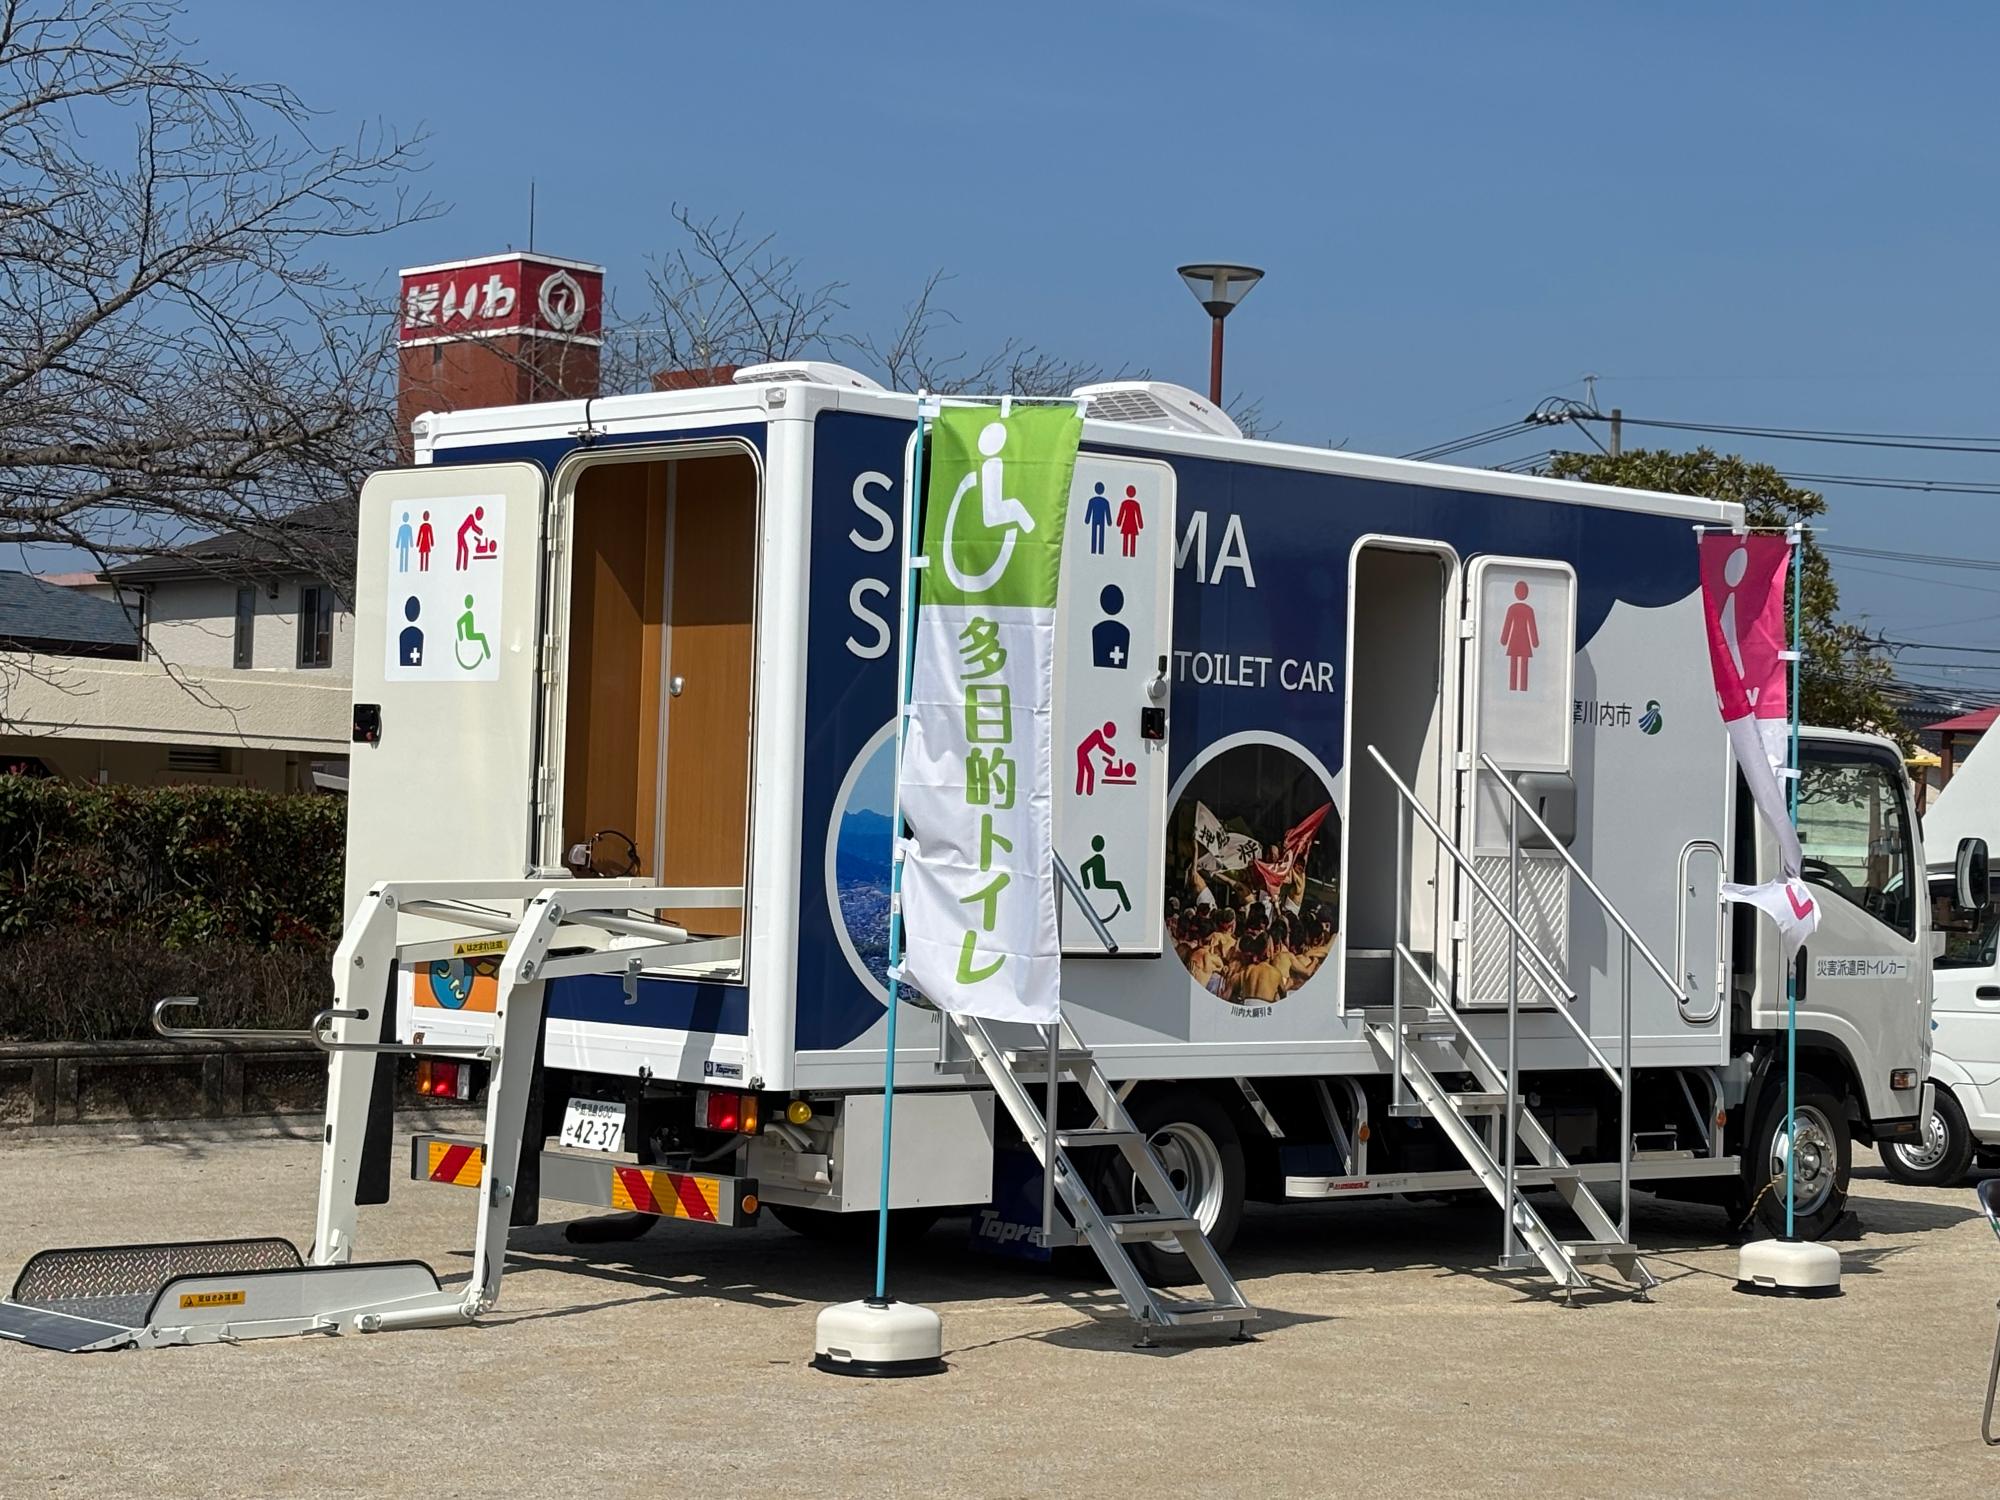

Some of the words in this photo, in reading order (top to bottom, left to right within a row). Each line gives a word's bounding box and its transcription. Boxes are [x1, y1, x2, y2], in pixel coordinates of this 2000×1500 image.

[1174, 651, 1273, 688] TOILET
[1280, 658, 1334, 693] CAR
[956, 616, 1017, 985] 多目的トイレ
[1816, 959, 1906, 977] 災害派遣用トイレカー
[574, 1119, 620, 1147] 42-37
